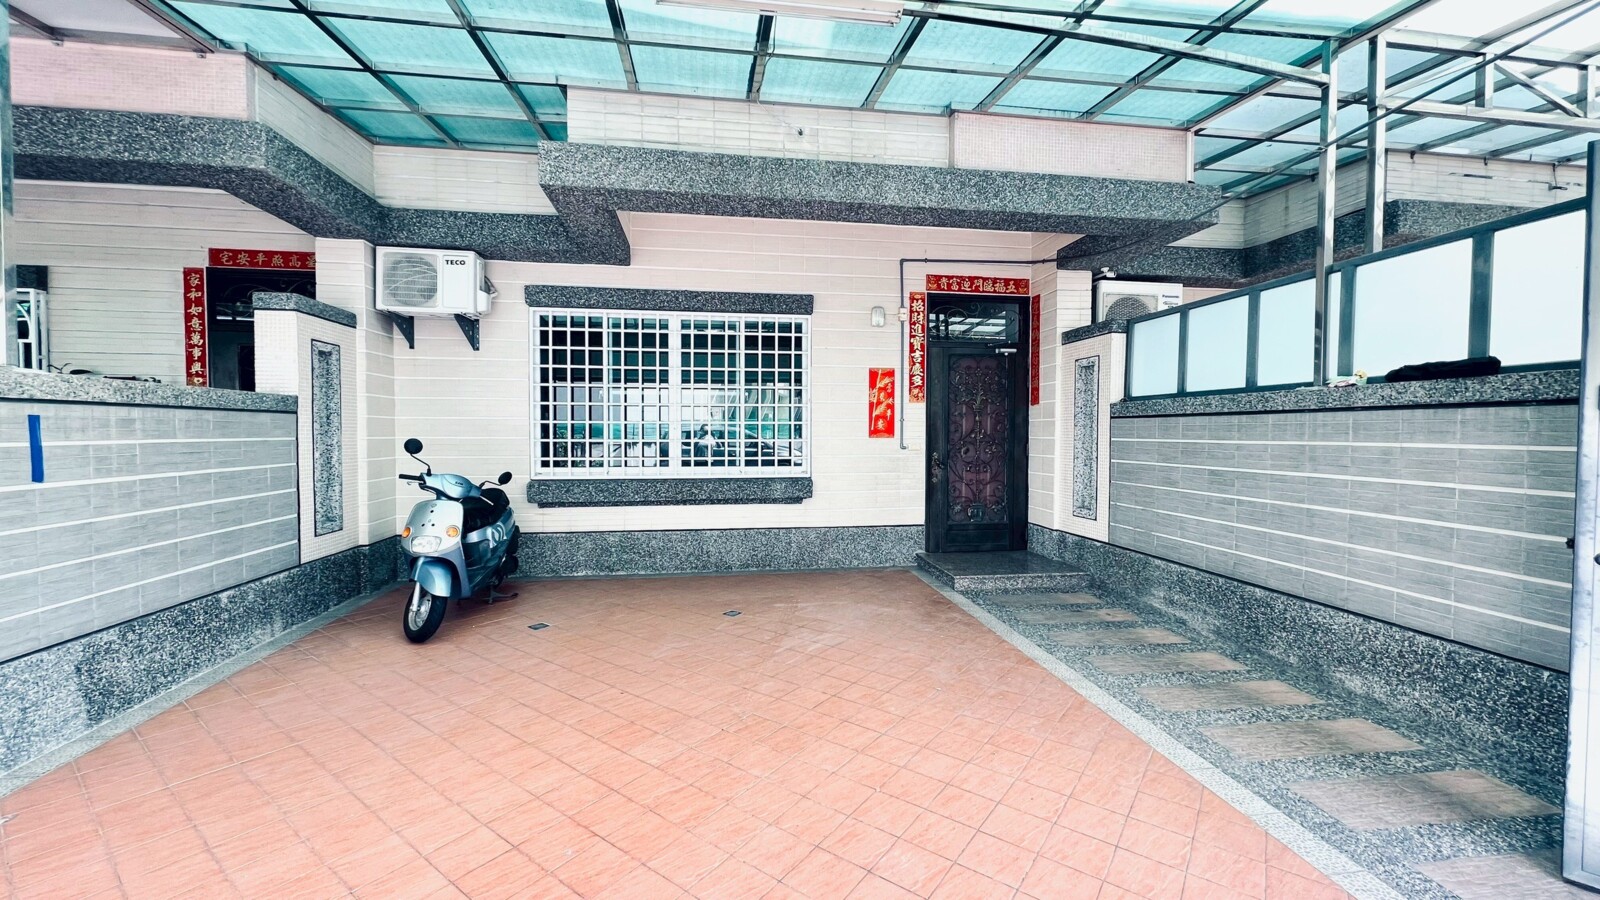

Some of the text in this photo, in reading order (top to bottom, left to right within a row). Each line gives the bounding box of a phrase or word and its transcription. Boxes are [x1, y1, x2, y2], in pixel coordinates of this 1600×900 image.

[187, 273, 204, 375] 家和如意萬事興
